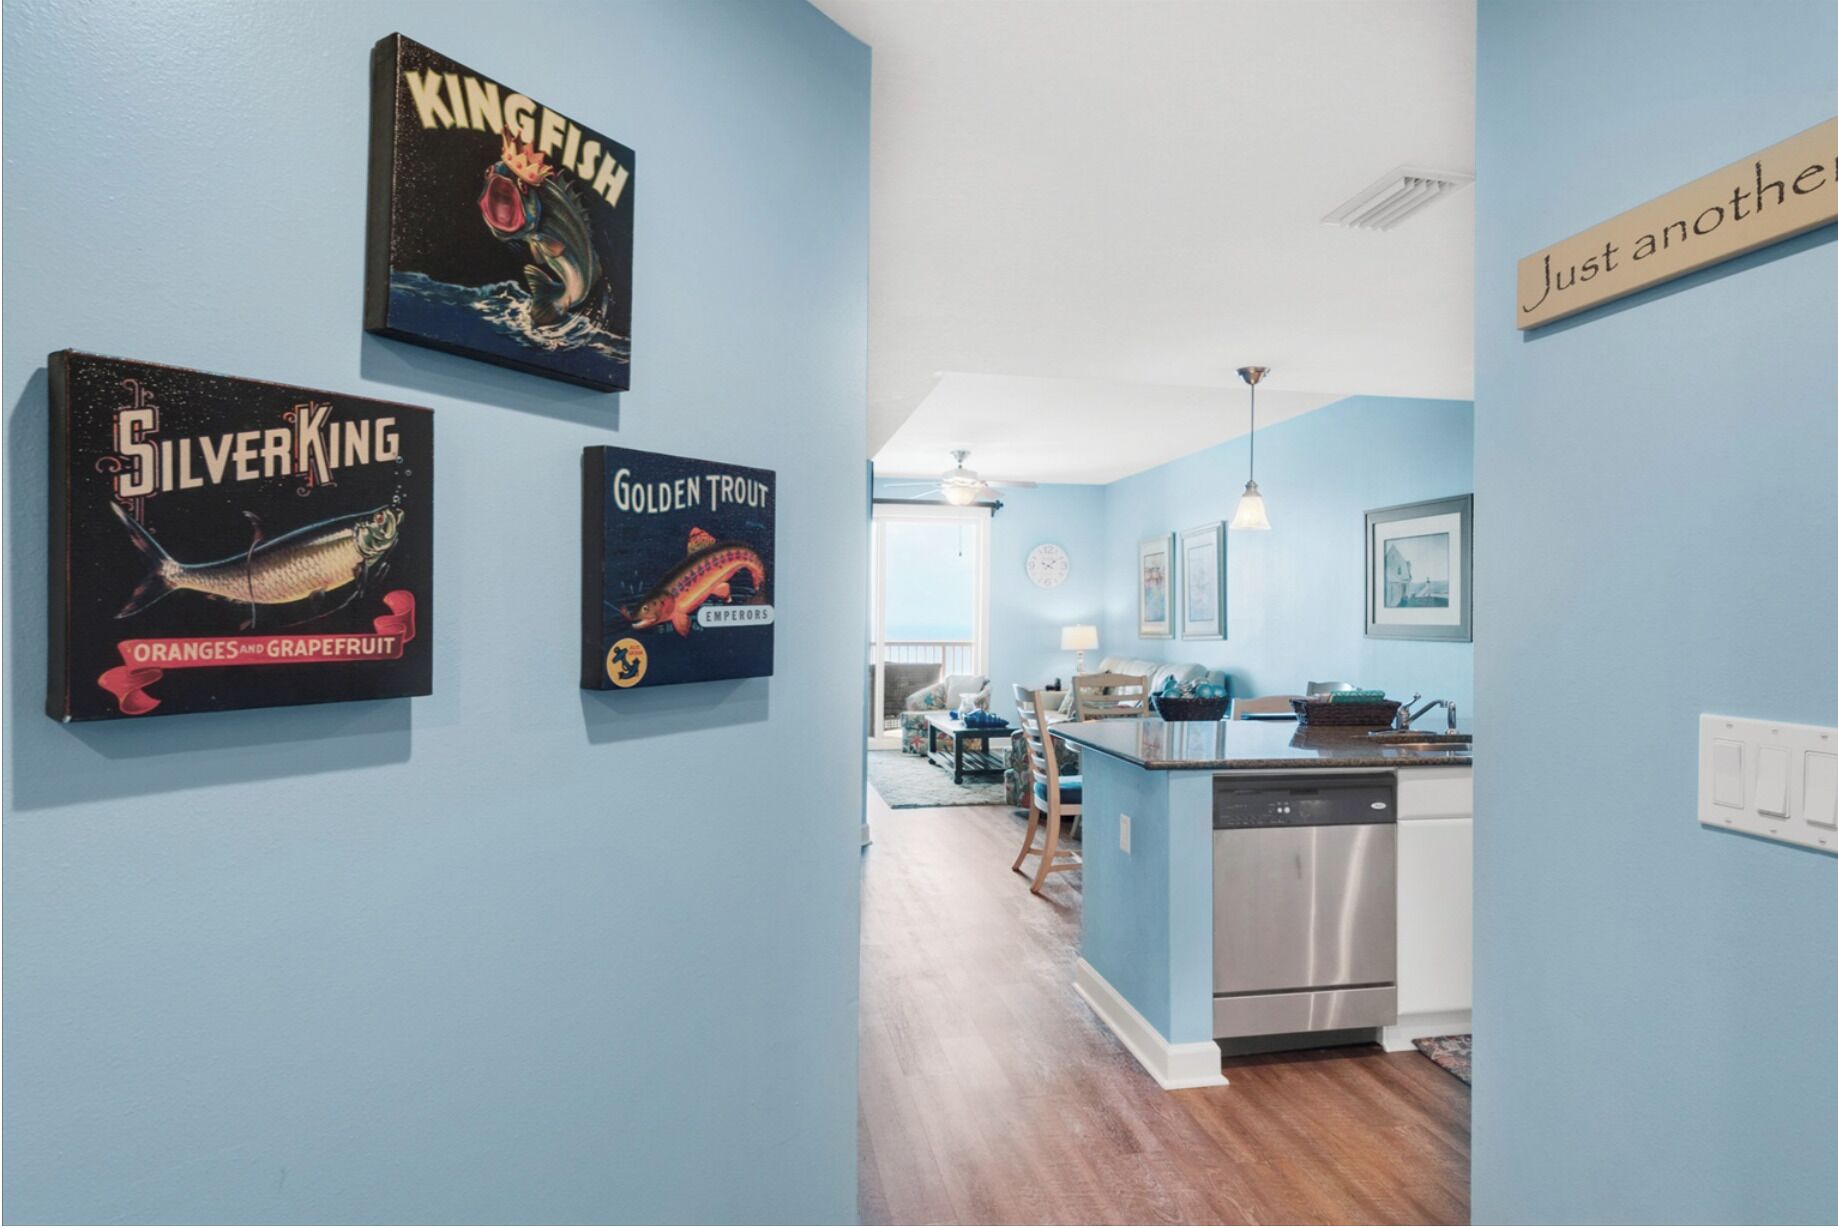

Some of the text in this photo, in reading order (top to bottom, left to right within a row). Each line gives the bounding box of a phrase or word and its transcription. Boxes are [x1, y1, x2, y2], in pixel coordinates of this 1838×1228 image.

[404, 66, 630, 209] KINGFISH
[1522, 157, 1838, 313] Just anothe
[613, 468, 769, 514] GOLDEN TROUT
[705, 608, 769, 622] EMPERORS
[133, 637, 396, 663] ORANGES AND GRAPEFRUIT
